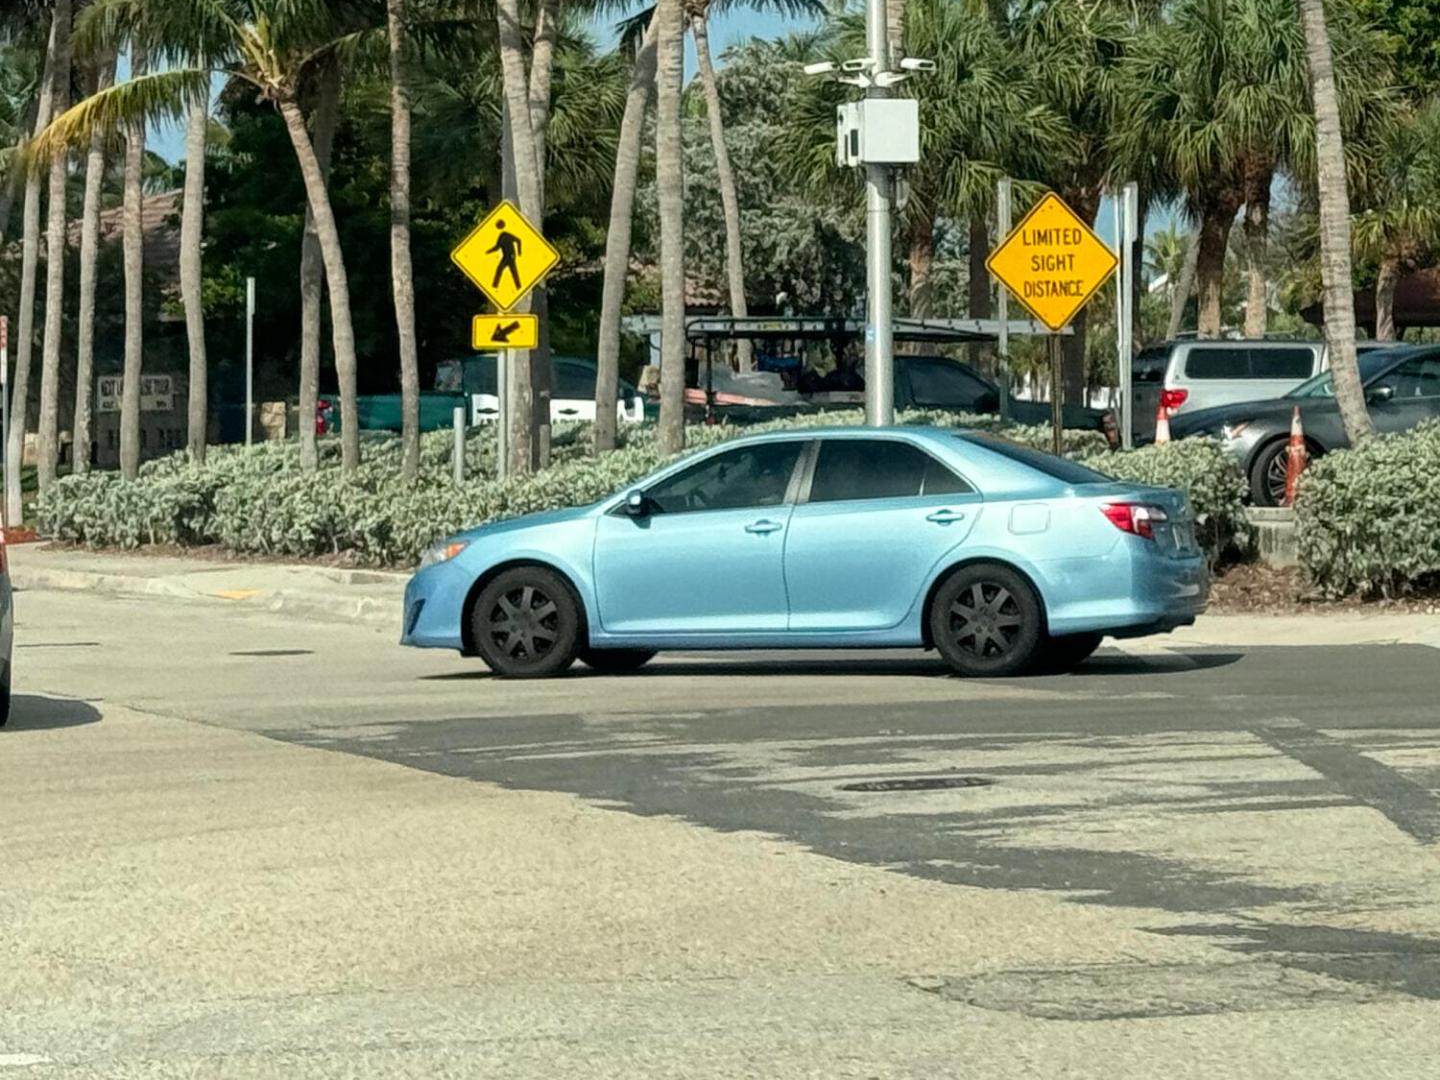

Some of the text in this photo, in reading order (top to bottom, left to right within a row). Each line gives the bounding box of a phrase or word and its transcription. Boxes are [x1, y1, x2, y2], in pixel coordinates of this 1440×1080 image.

[1022, 228, 1082, 246] LIMITED
[1031, 254, 1075, 272] SIGHT
[1024, 280, 1084, 298] DISTANCE
